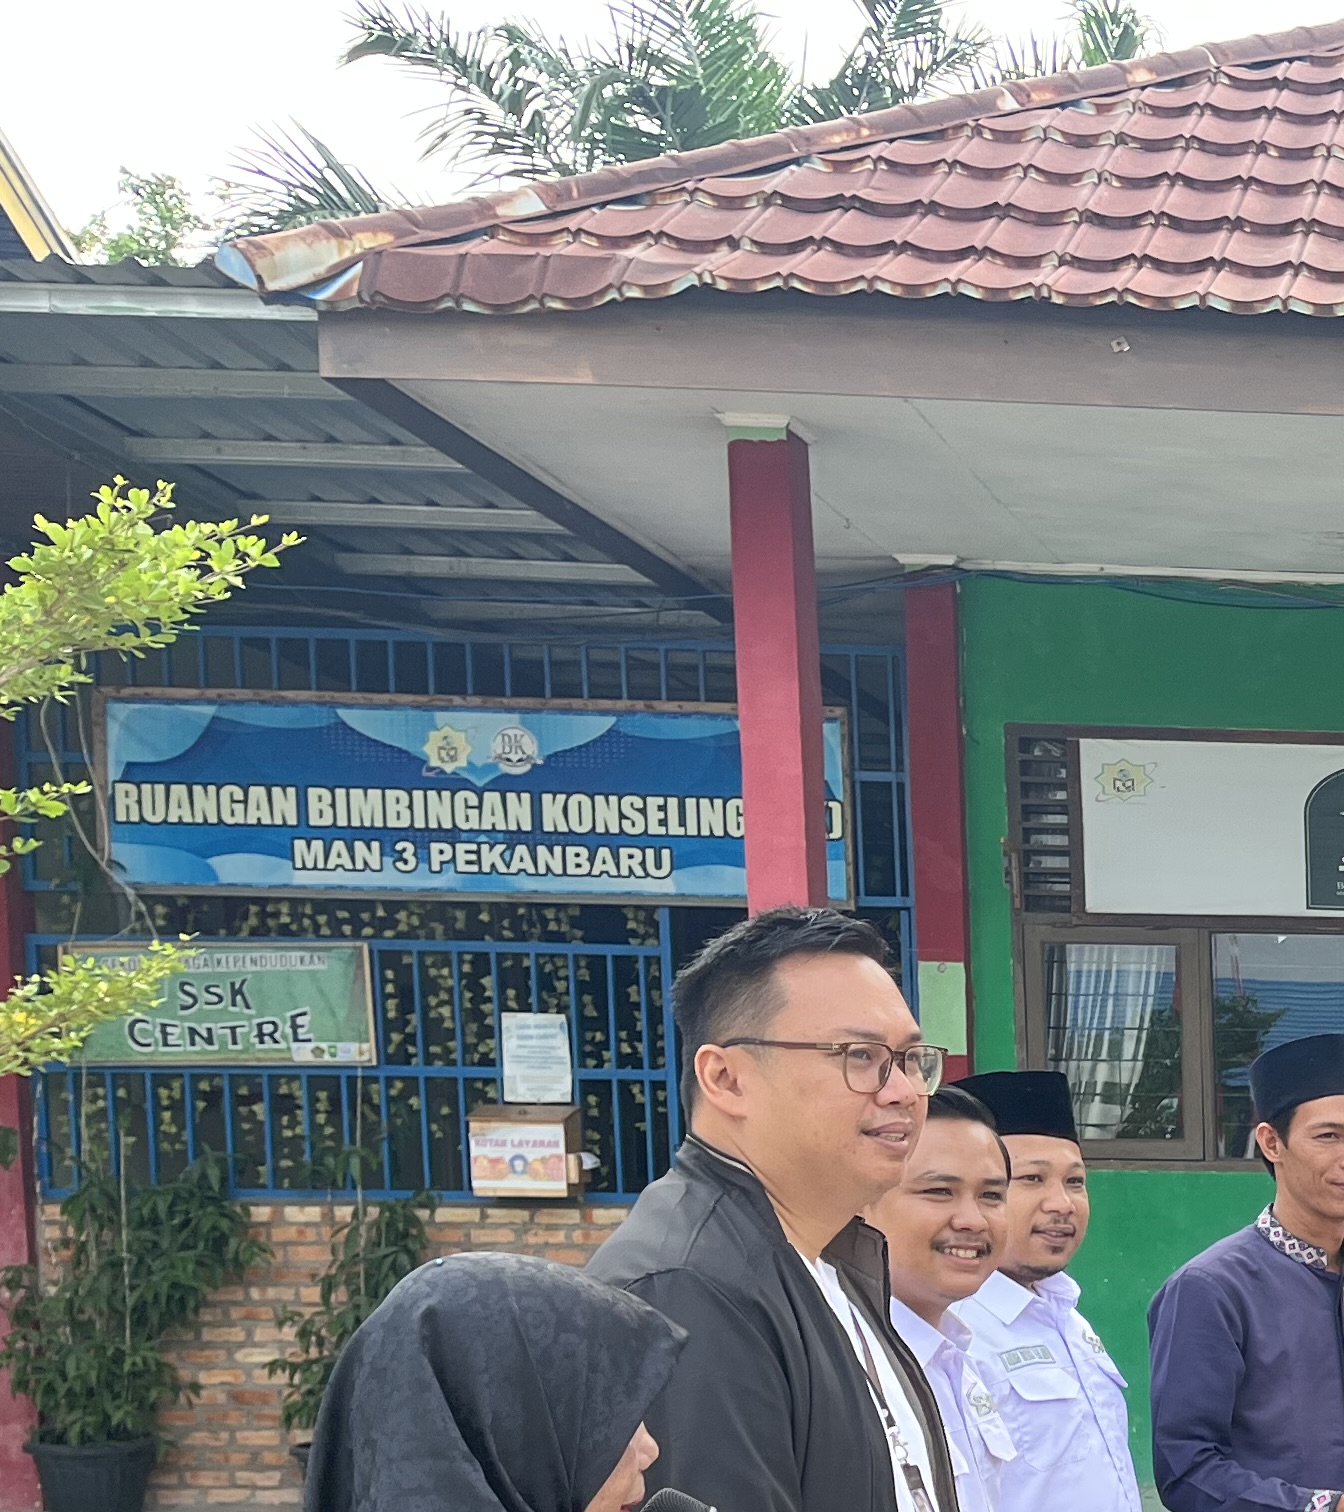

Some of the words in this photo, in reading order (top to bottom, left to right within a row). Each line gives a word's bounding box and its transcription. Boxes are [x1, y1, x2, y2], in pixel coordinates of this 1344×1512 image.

[114, 782, 298, 826] RUANGAN
[307, 787, 532, 832] BIMBINGAN
[541, 792, 745, 838] KONSELING
[292, 838, 382, 872] MAN
[395, 841, 418, 873] 3
[428, 841, 673, 879] PEKANBARU
[214, 953, 327, 972] KEPENDUDUKAN
[127, 1010, 313, 1048] CENTRE
